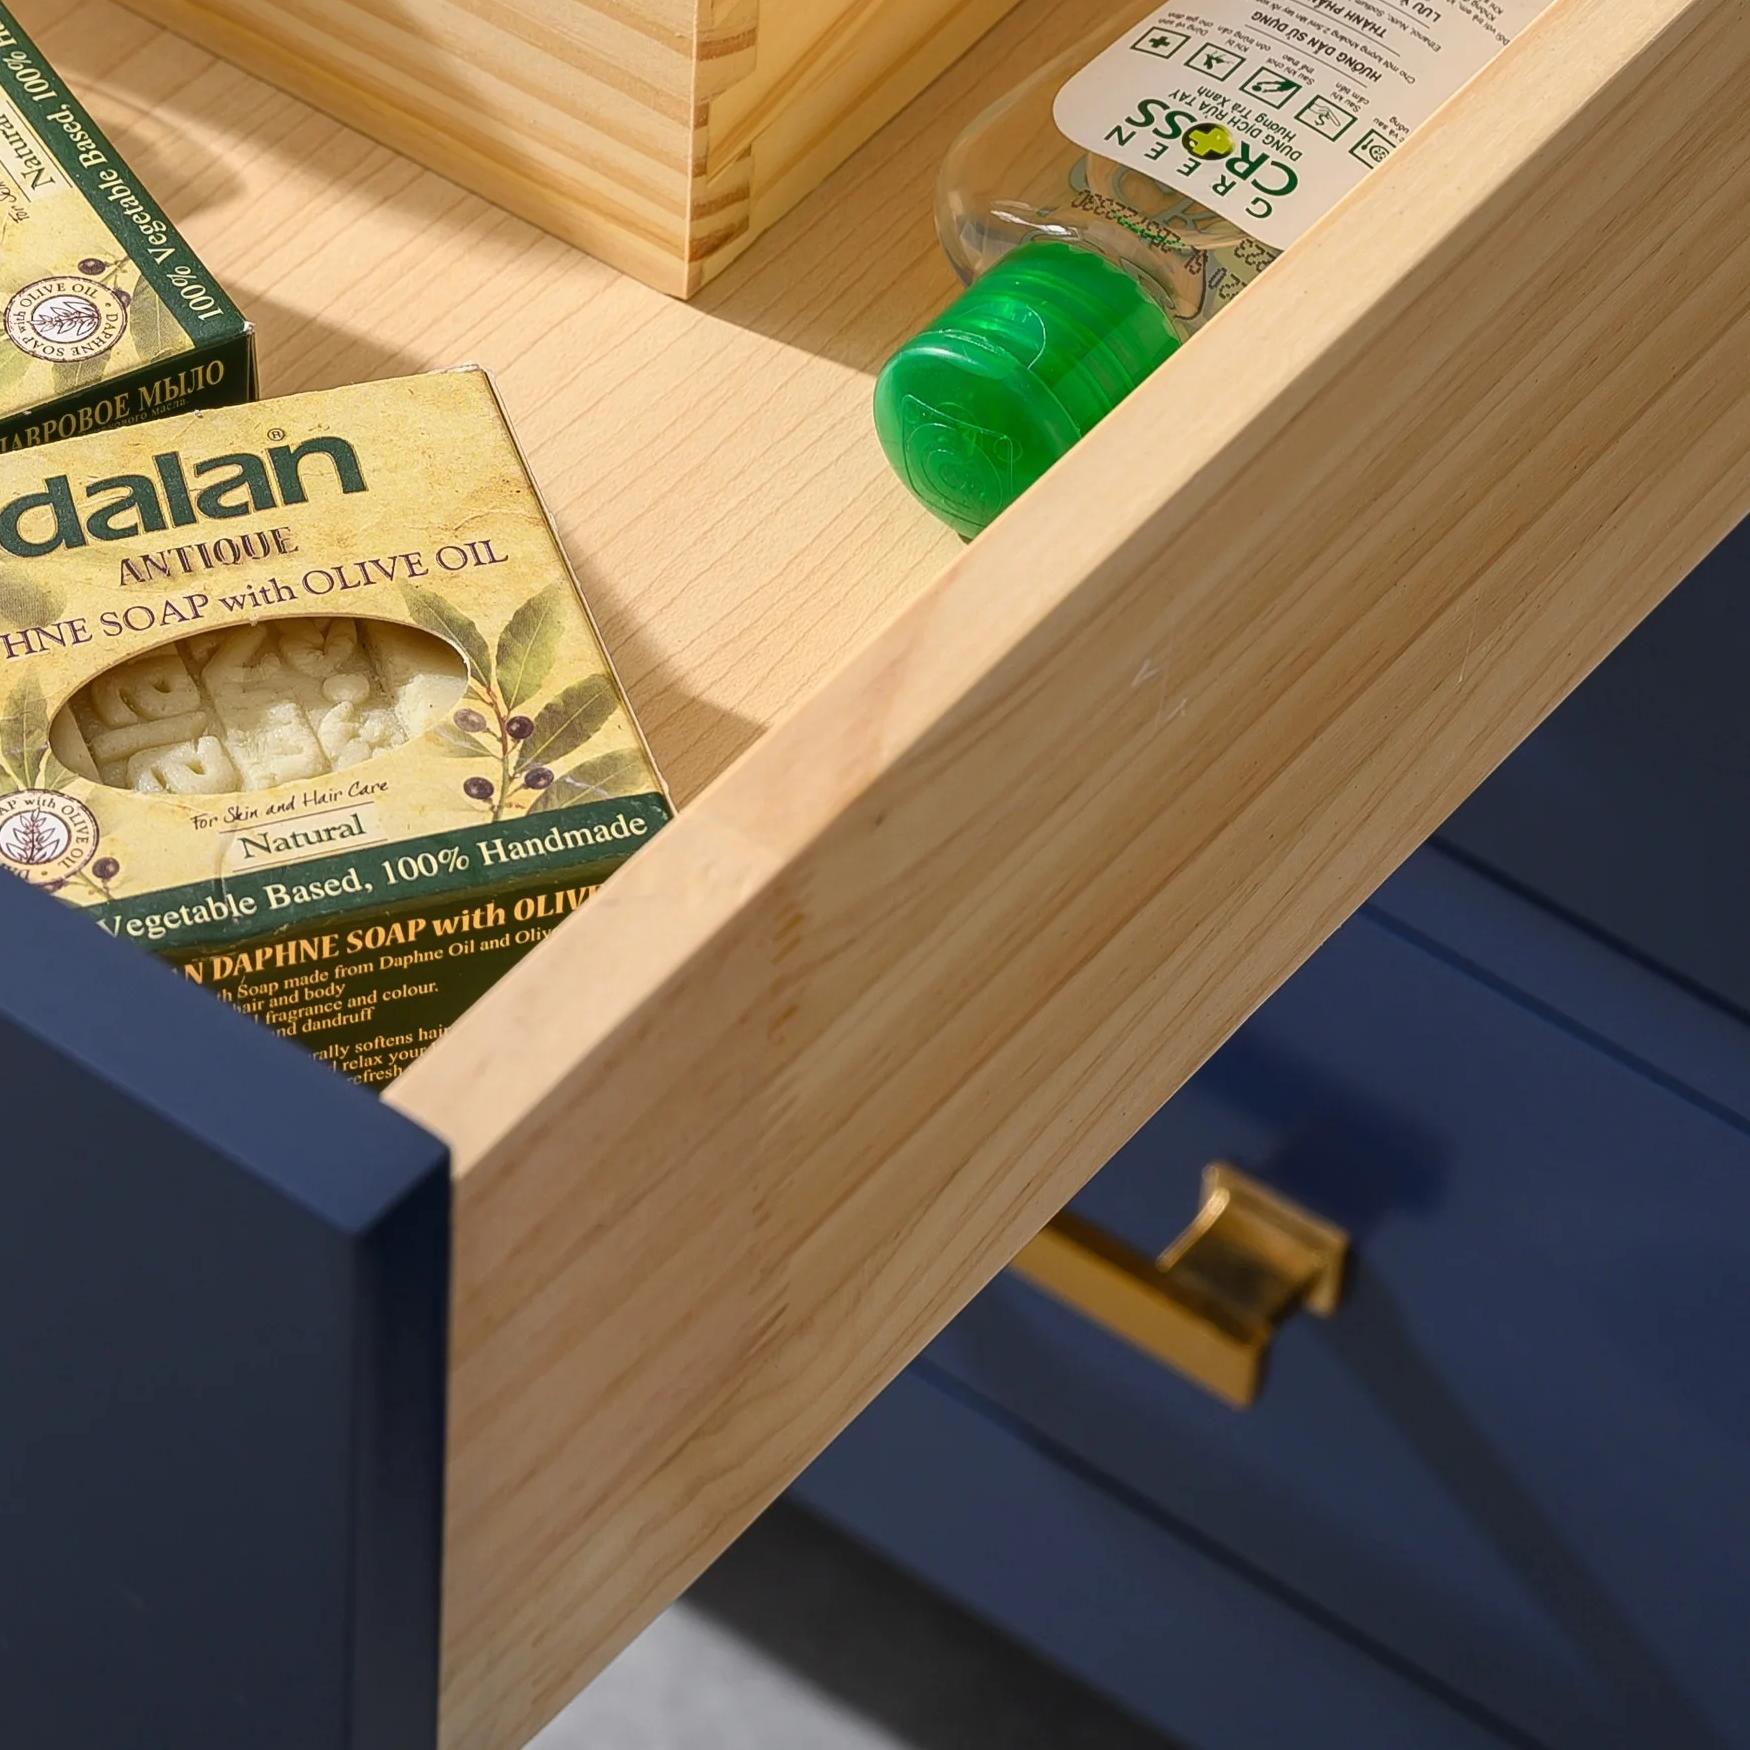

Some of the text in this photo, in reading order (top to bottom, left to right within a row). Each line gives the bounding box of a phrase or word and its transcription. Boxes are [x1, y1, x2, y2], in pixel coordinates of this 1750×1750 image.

[1251, 11, 1288, 32] DỤNG
[1343, 10, 1387, 38] THÀNH
[1412, 2, 1441, 22] LƯU
[1306, 37, 1336, 56] DẪN
[1336, 52, 1382, 82] HƯỚNG
[2, 51, 57, 101] 100%
[46, 104, 108, 169] Based,
[1168, 89, 1303, 162] DUNG DỊCH RỬA TAY
[1197, 86, 1296, 143] Hương Trà Xanh
[1104, 117, 1272, 218] GREEN
[1124, 94, 1298, 204] CROSS
[8, 205, 30, 224] For
[98, 169, 175, 265] Vegetable
[166, 266, 224, 320] 100%
[13, 282, 119, 358] DAPHNE SOAP with OLIVE OIL
[138, 360, 224, 412] МЫЛО
[120, 526, 298, 586] ANTIQUE
[100, 594, 209, 636] SOAP
[218, 578, 298, 612] with
[302, 552, 429, 595] OLIVE
[436, 539, 508, 571] OIL
[23, 796, 57, 809] with
[61, 805, 90, 844] OLIVE
[190, 781, 388, 830] For Skin and Hair Care
[58, 848, 84, 869] OIL
[238, 813, 366, 859] Natural
[264, 868, 373, 910] Based,
[382, 846, 469, 884] 100%
[476, 814, 648, 866] Handmade
[210, 934, 339, 980] DAPHNE
[346, 918, 426, 954] SOAP
[432, 902, 505, 936] with
[237, 933, 510, 998] Soap made from Daphne Oil and
[266, 982, 438, 1025] fragrance and colour.
[269, 982, 346, 1008] and body
[302, 1006, 375, 1032] dandruff
[342, 1055, 383, 1071] relax
[355, 1034, 413, 1053] softens
